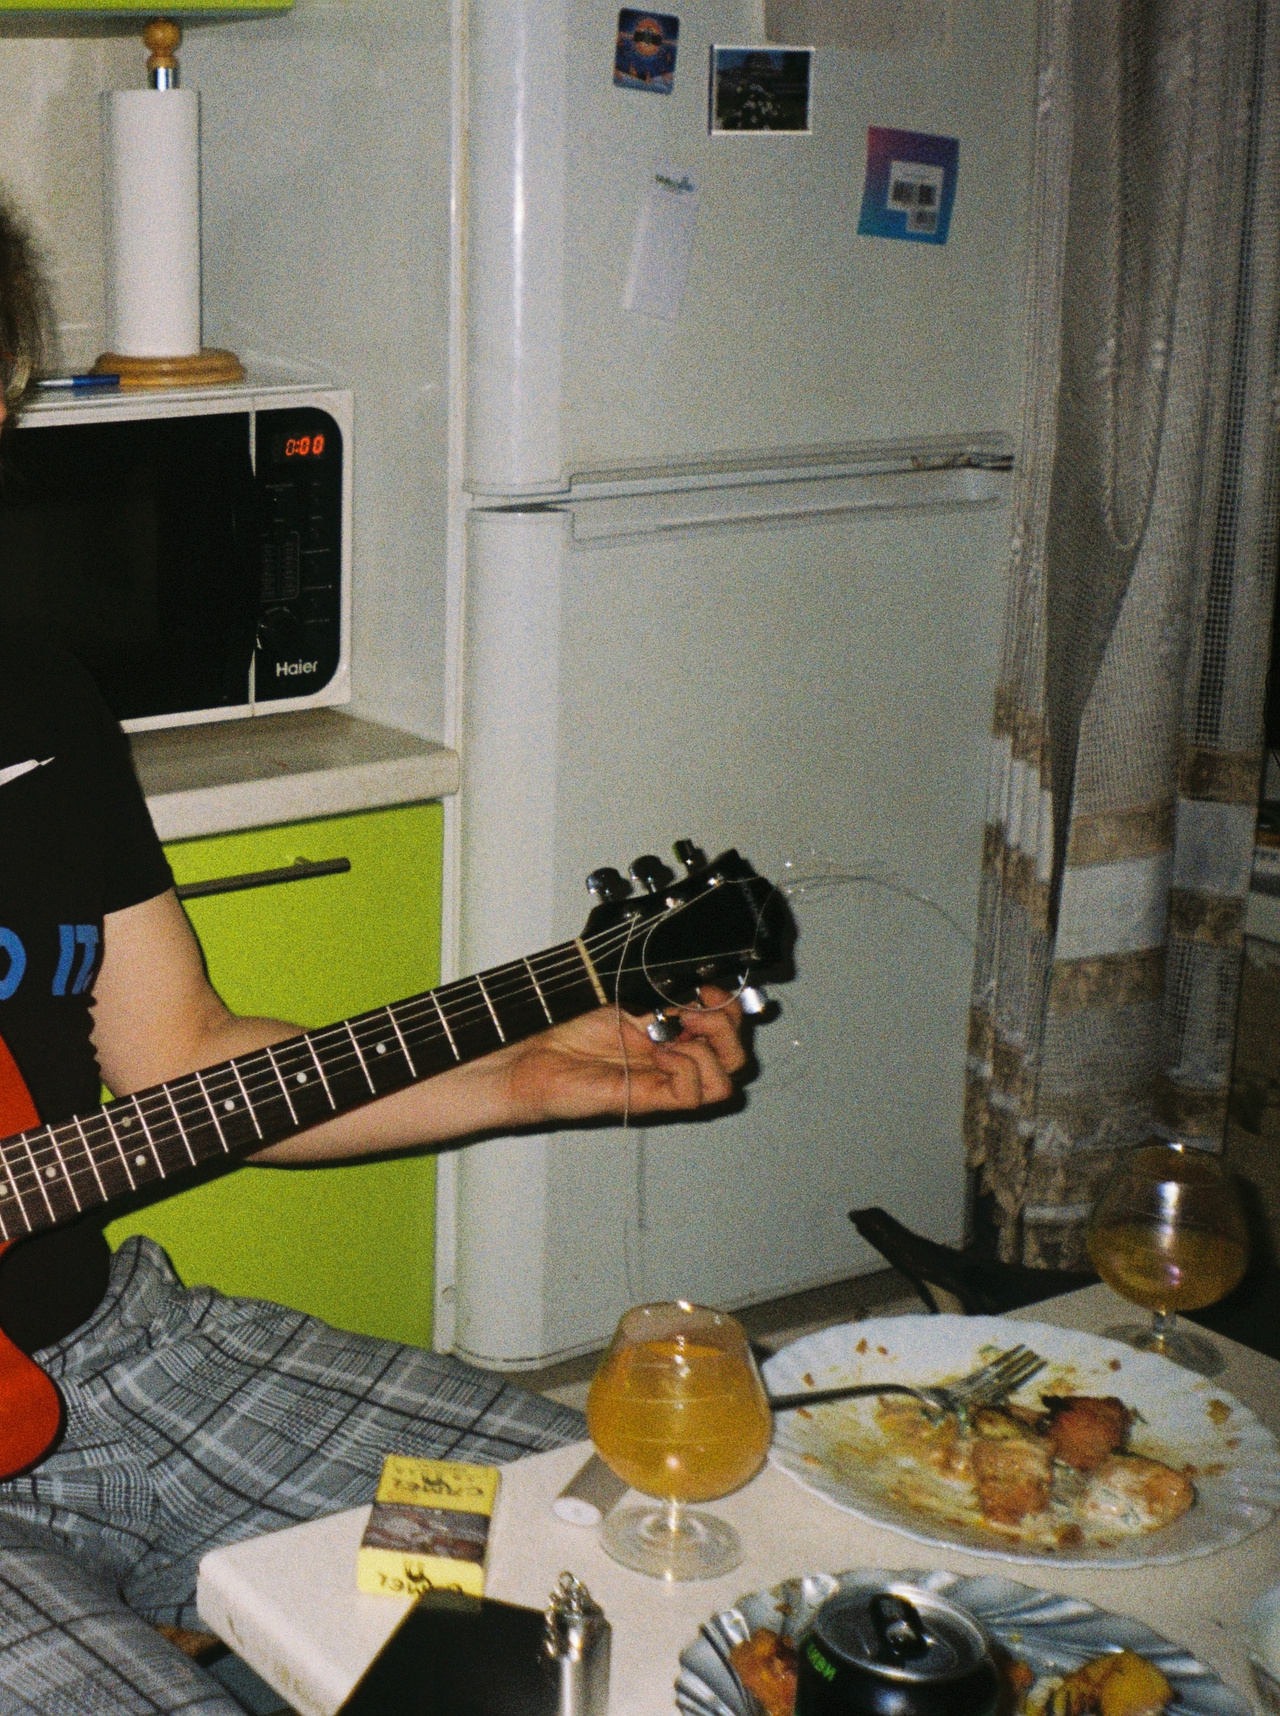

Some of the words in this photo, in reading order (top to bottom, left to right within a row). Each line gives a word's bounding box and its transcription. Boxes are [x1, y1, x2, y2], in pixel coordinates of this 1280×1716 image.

[285, 433, 326, 457] 0:00
[275, 658, 319, 678] Haier
[51, 923, 100, 997] IT
